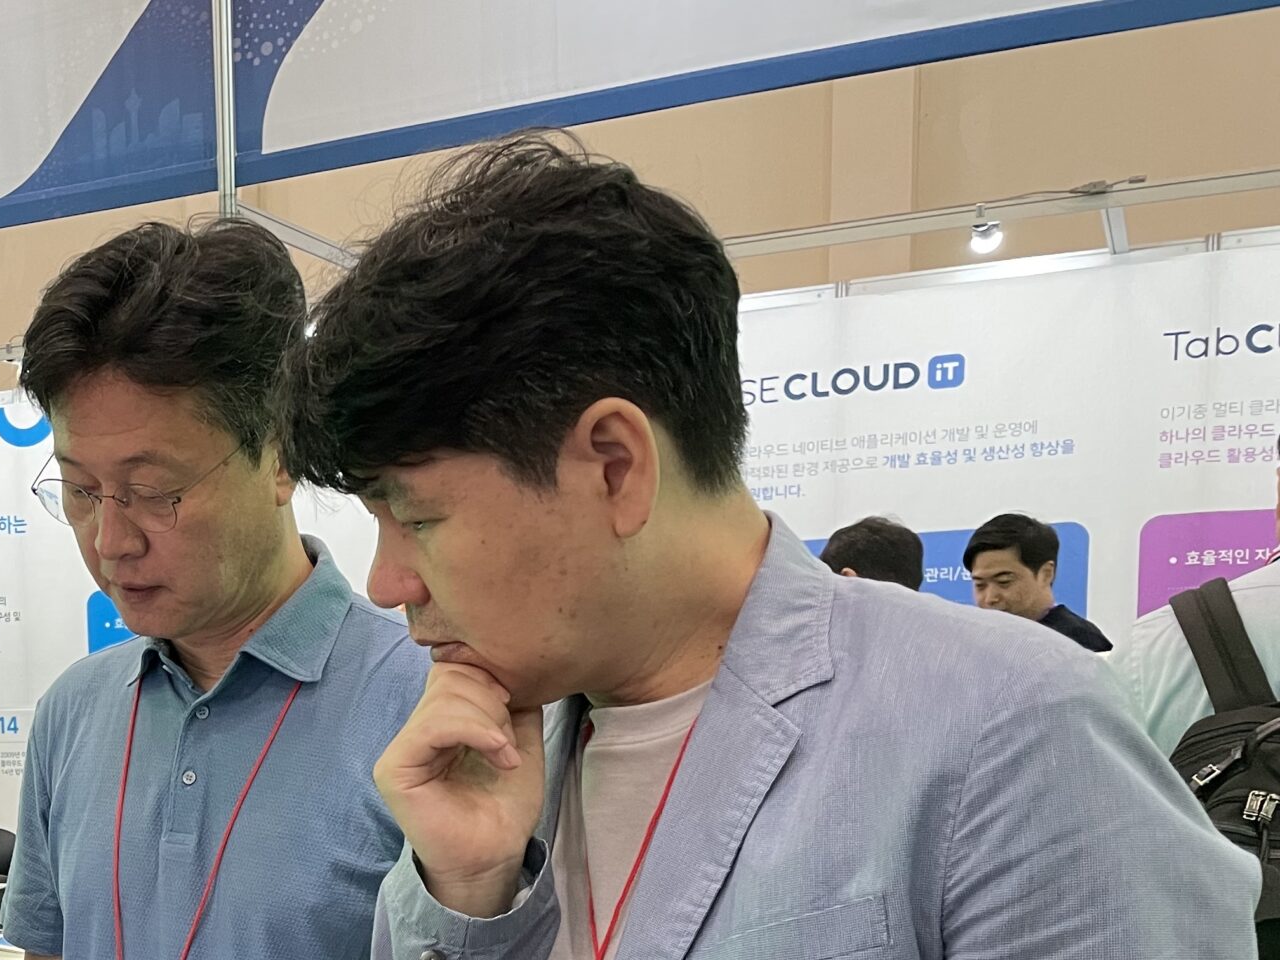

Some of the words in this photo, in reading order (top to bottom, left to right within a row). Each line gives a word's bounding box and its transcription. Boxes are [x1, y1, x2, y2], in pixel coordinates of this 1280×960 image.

[1163, 323, 1280, 361] TabC
[1160, 404, 1207, 421] 이기종
[1212, 401, 1244, 418] 멀티
[792, 438, 847, 455] 네이티브
[851, 429, 937, 449] 애플리케이션
[941, 426, 970, 442] 개발
[974, 424, 989, 439] 및
[992, 420, 1038, 438] 운영에
[1159, 426, 1206, 444] 하나의
[1211, 423, 1276, 441] 클라우드
[745, 462, 789, 481] 적화된
[793, 461, 818, 478] 환경
[822, 456, 878, 474] 제공으로
[883, 453, 910, 468] 개발
[915, 450, 958, 466] 효율성
[963, 448, 977, 462] 및
[981, 444, 1025, 461] 생산성
[1030, 439, 1075, 457] 향상을
[1158, 450, 1221, 468] 클라우드
[1227, 446, 1277, 464] 활용성
[1185, 548, 1250, 566] 효율적인
